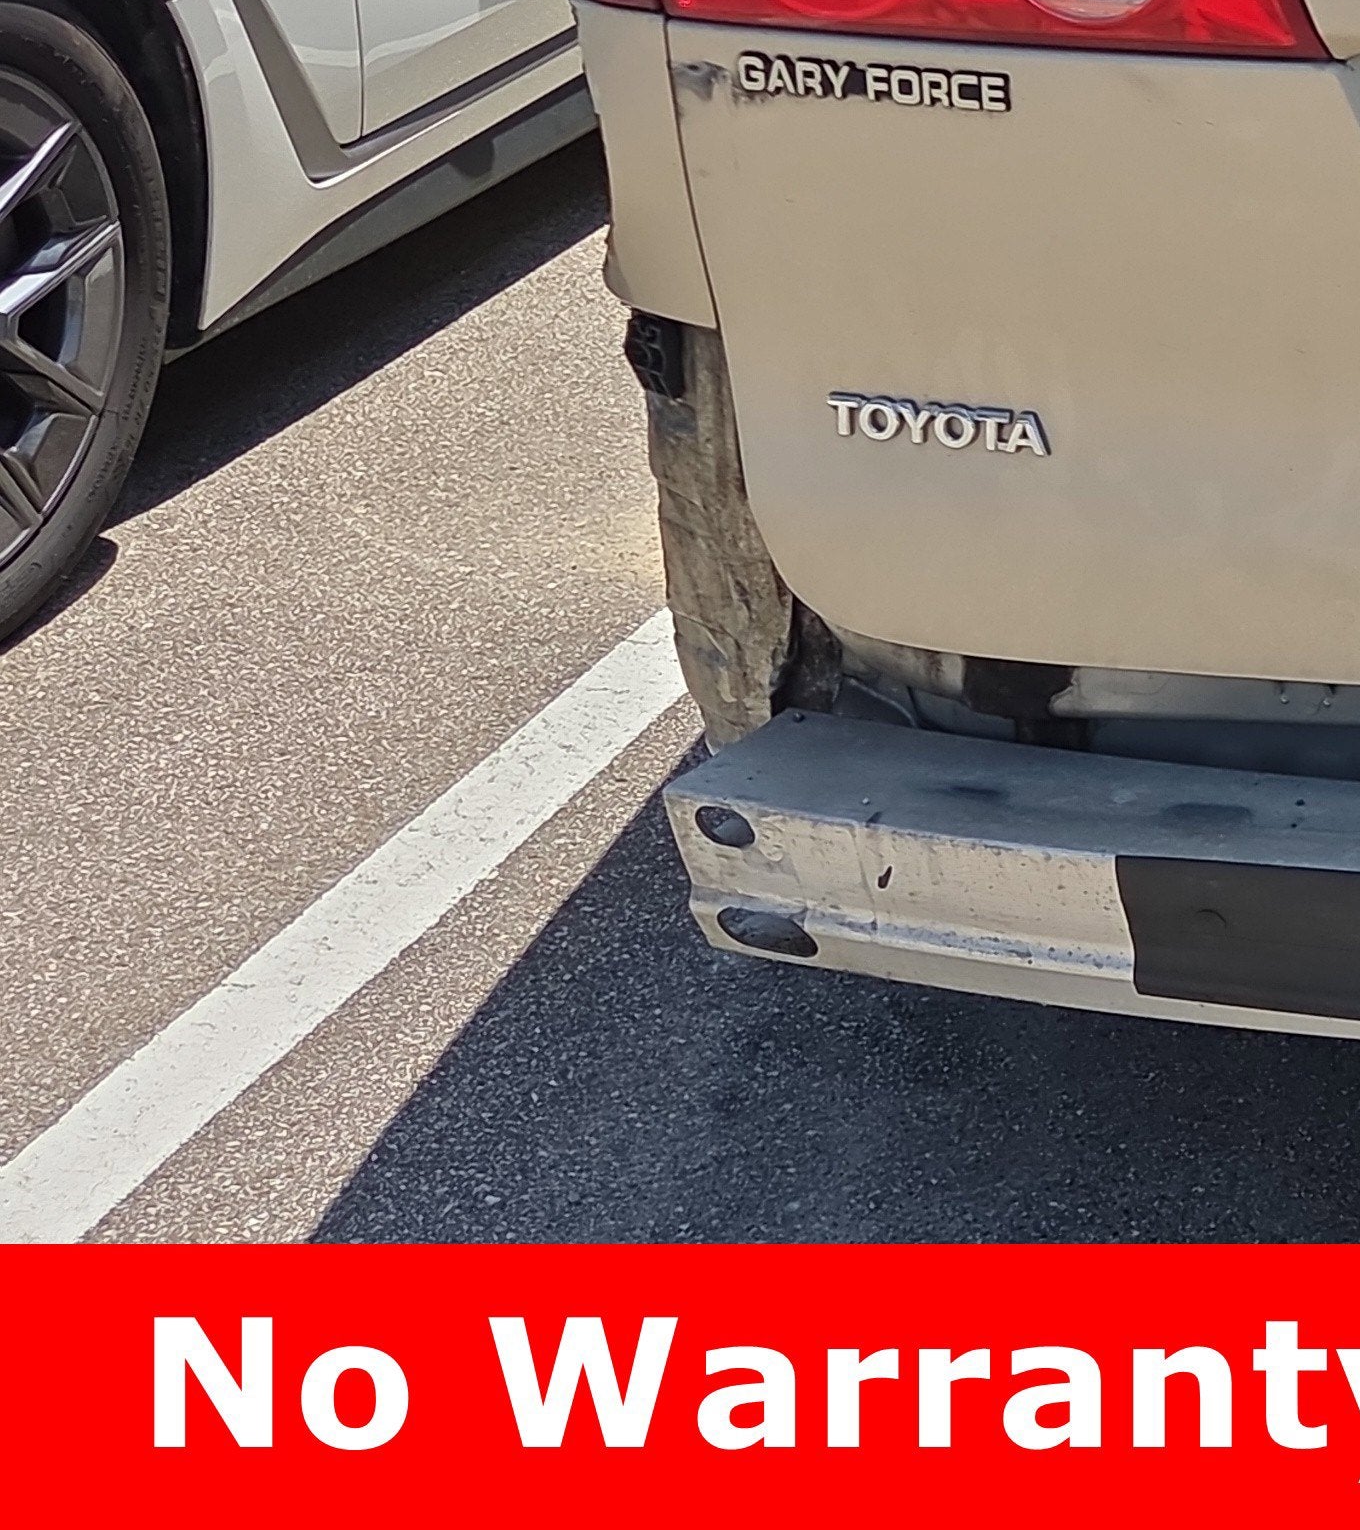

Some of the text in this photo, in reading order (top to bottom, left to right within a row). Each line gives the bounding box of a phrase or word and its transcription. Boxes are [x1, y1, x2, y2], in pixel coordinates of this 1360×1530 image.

[738, 52, 1010, 113] GARY FORCE
[826, 391, 1051, 457] TOYOTA
